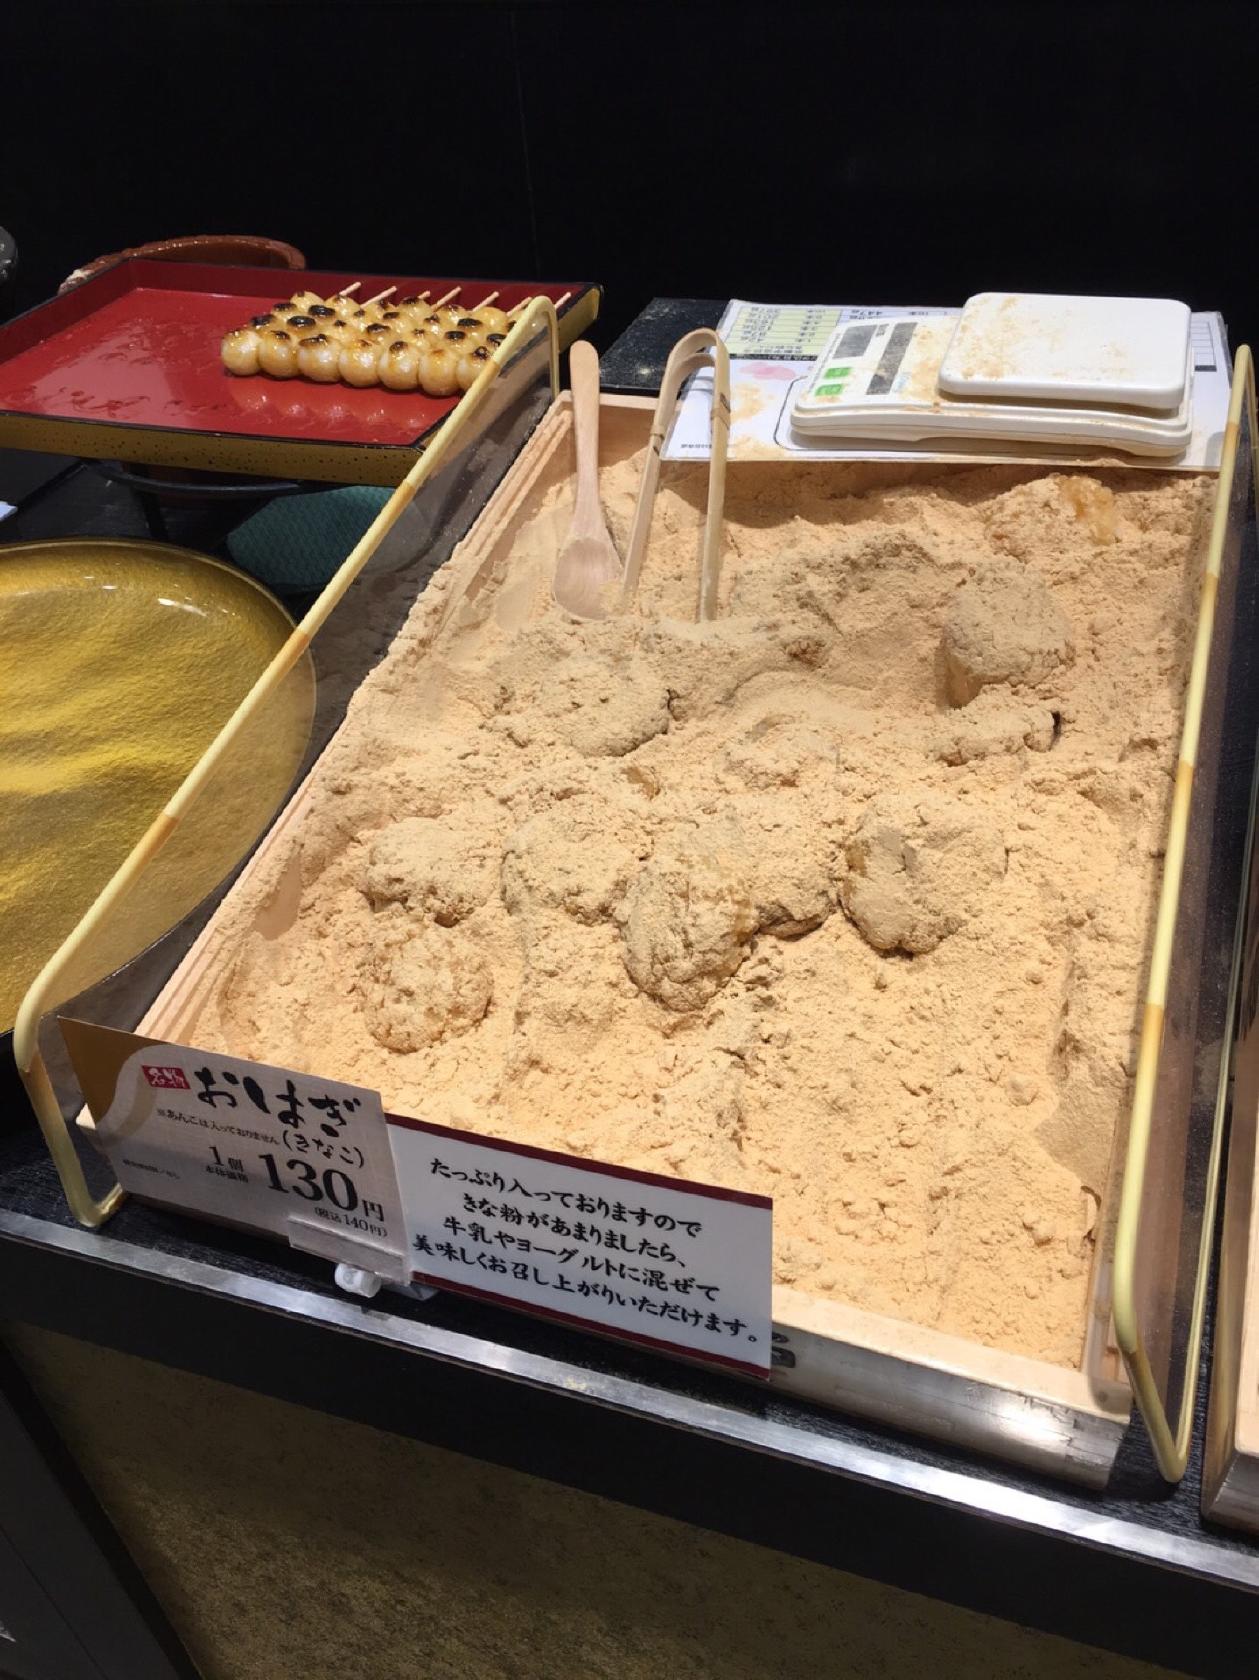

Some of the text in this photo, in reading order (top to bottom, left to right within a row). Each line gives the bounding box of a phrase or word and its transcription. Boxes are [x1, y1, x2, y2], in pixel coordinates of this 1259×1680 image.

[194, 1067, 361, 1137] おはぎ
[430, 1157, 702, 1238] たっぷり入っておりますので
[463, 1193, 687, 1269] きな粉があまりましたら、
[412, 1234, 758, 1343] 美味しくお召し上がりいただけます。
[444, 1216, 720, 1301] 牛乳やヨーグルトに混ぜて
